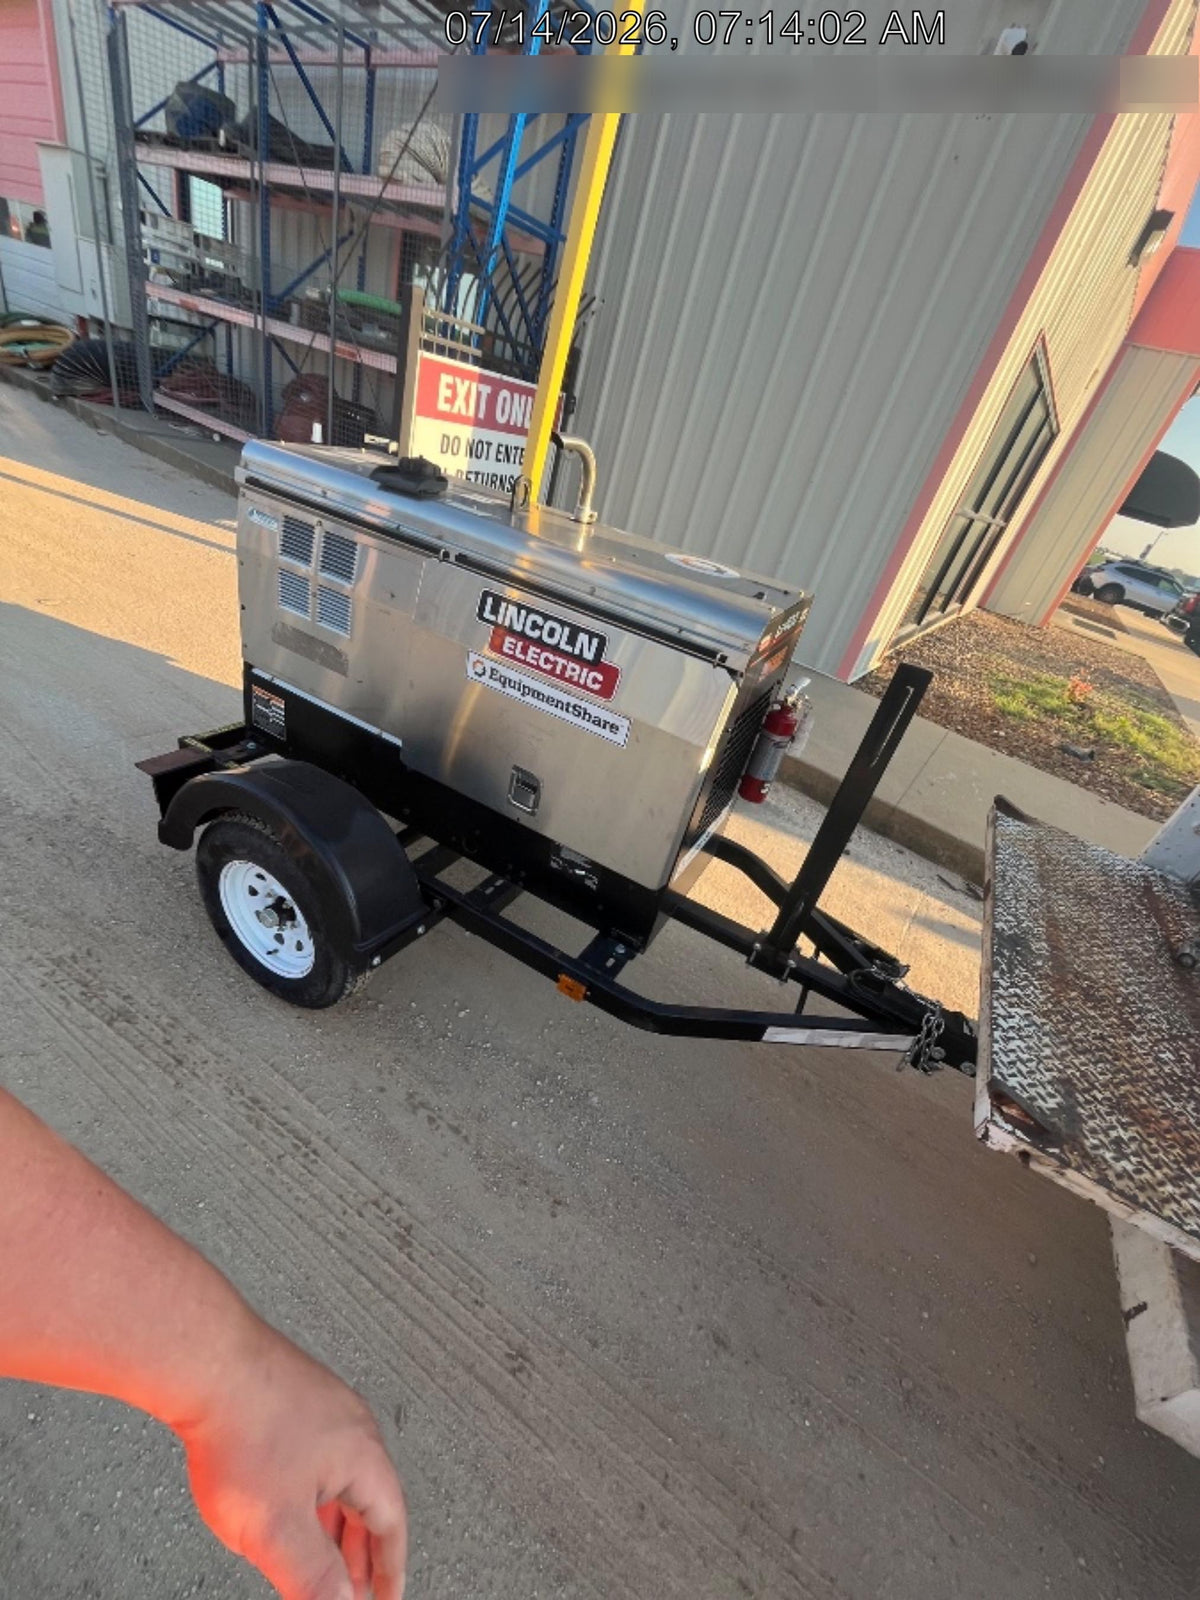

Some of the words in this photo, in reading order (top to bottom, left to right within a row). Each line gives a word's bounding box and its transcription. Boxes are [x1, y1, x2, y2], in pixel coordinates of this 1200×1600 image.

[437, 372, 491, 420] EXIT
[495, 388, 534, 429] ONL
[440, 433, 461, 456] DO
[466, 438, 493, 461] NOT
[495, 442, 526, 466] ENTE
[483, 596, 598, 662] LINCOLN
[502, 636, 604, 691] ELECTRIC
[489, 665, 620, 736] EquipmentShare
